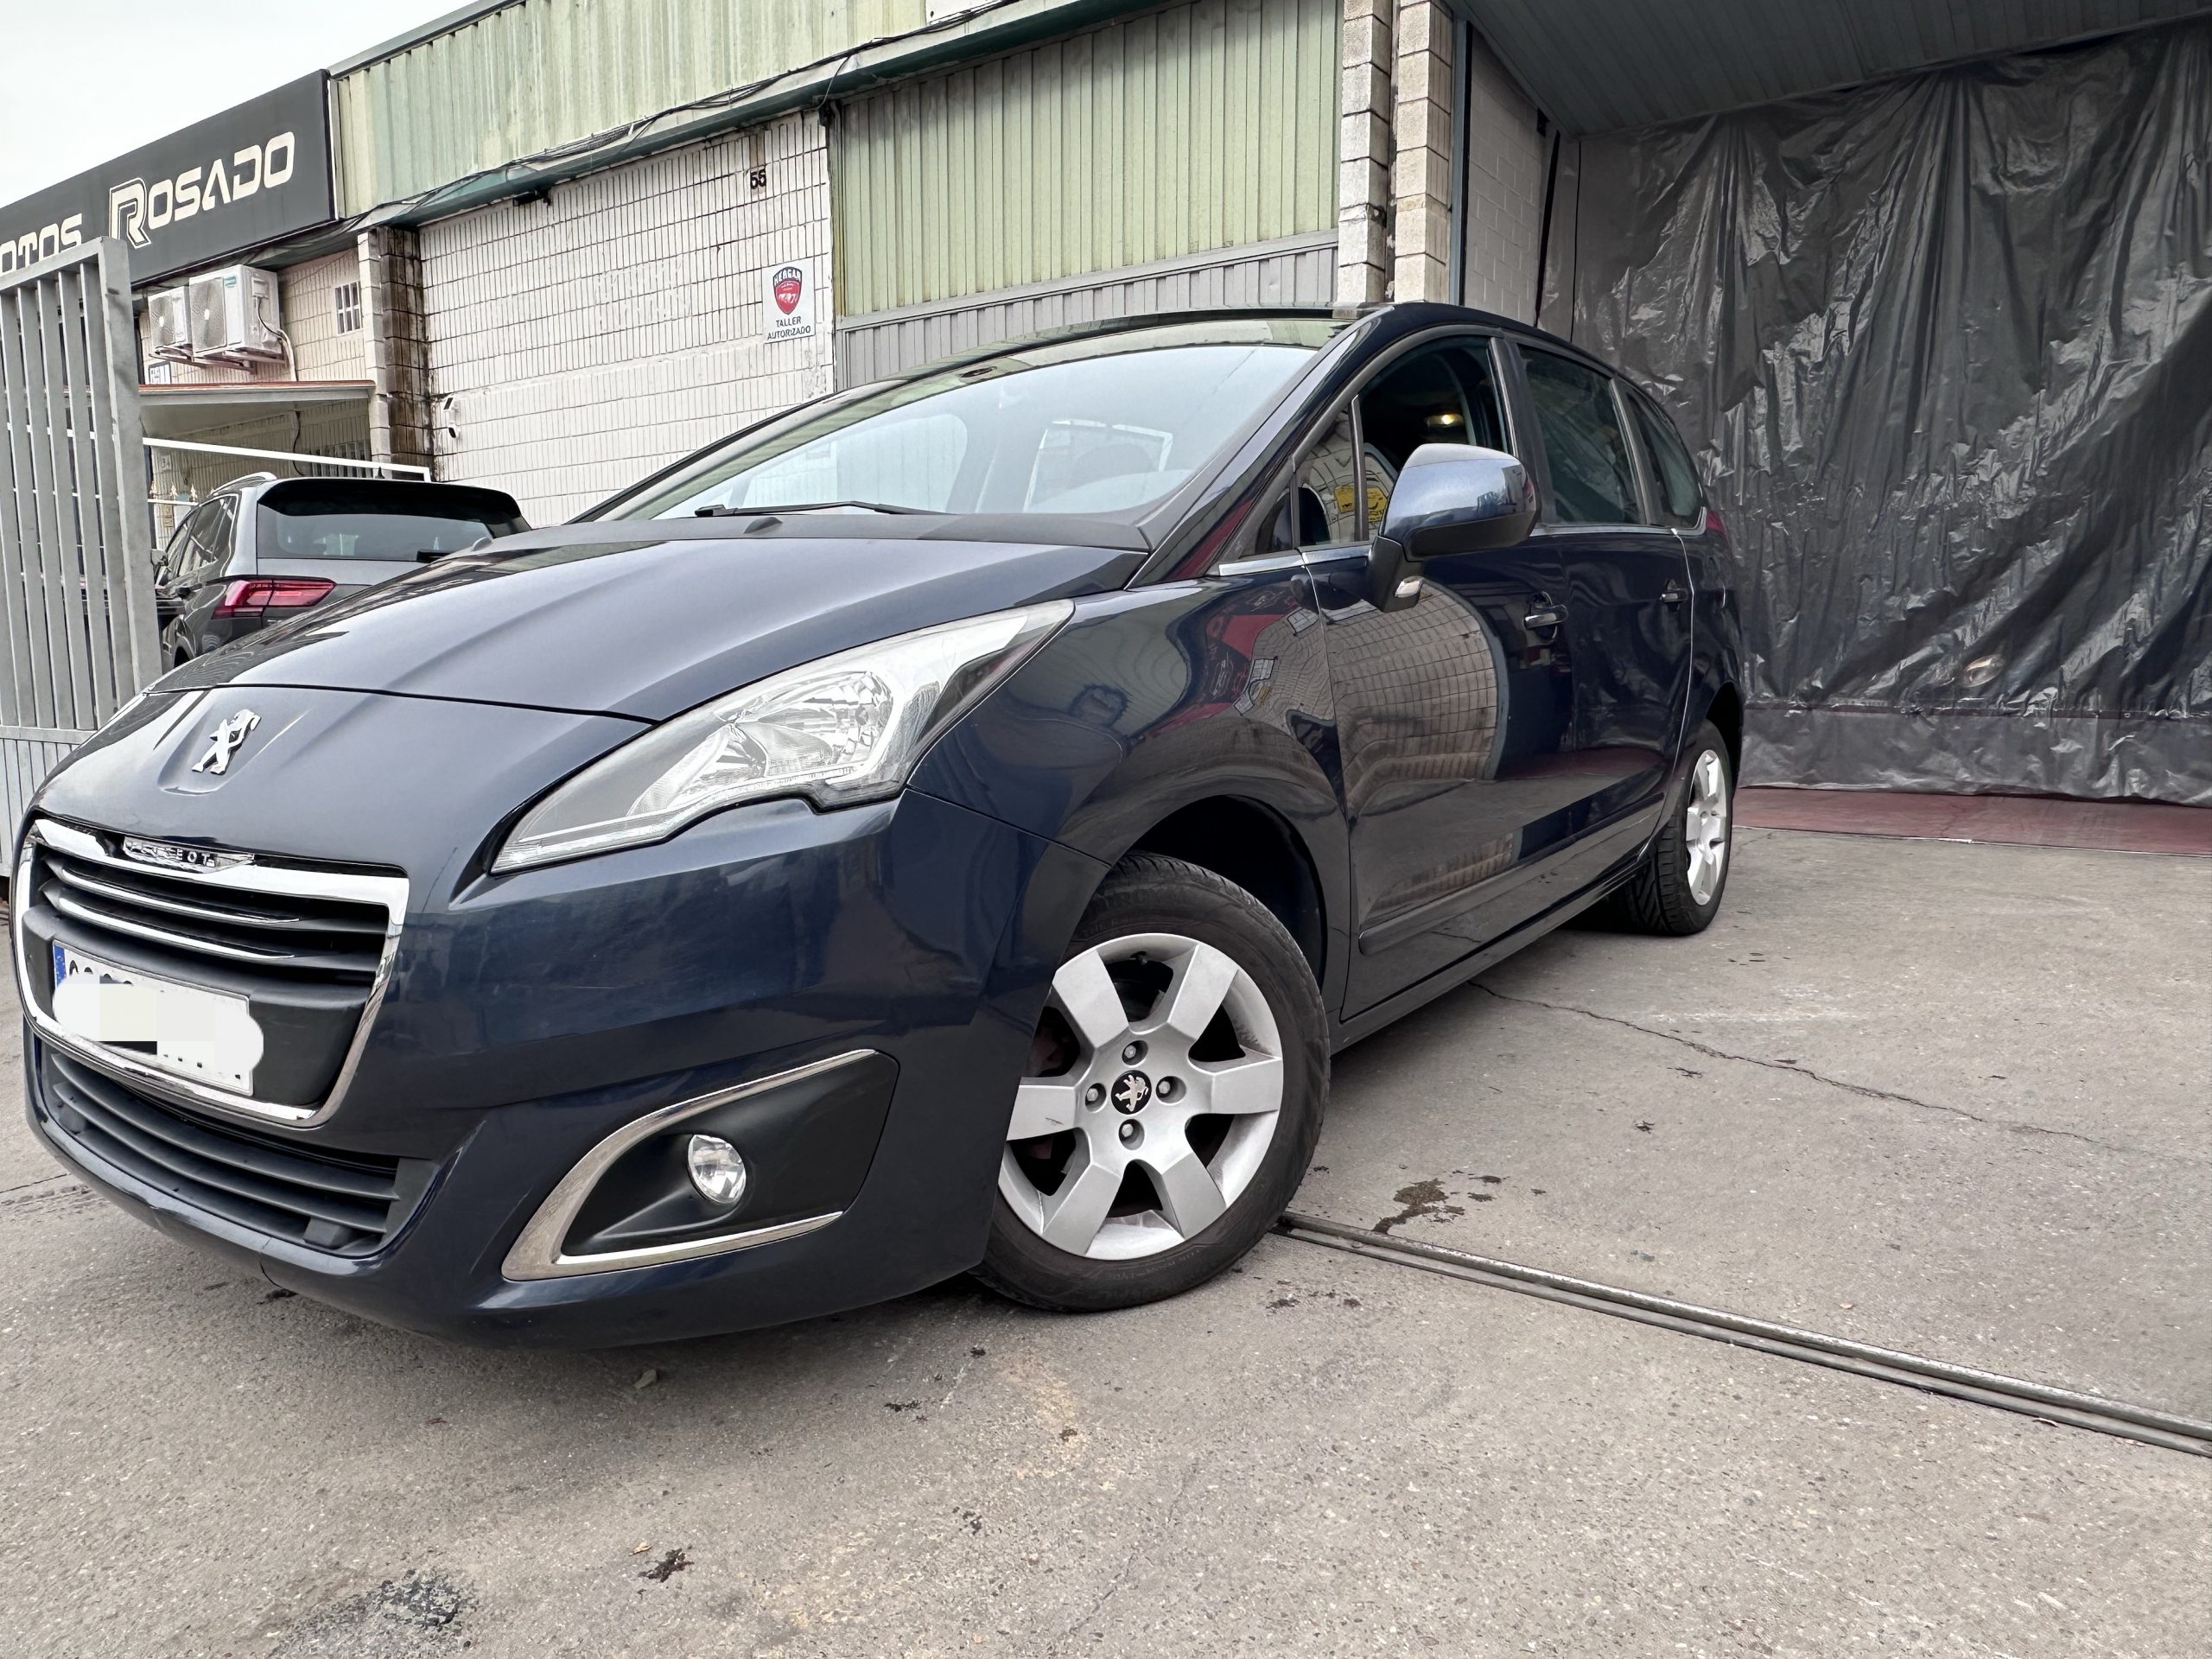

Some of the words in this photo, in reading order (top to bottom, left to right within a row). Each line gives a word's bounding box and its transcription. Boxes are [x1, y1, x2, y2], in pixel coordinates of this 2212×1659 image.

[109, 131, 295, 249] ROSADO
[776, 315, 802, 328] TALLER
[767, 325, 811, 340] AUTORIZADO
